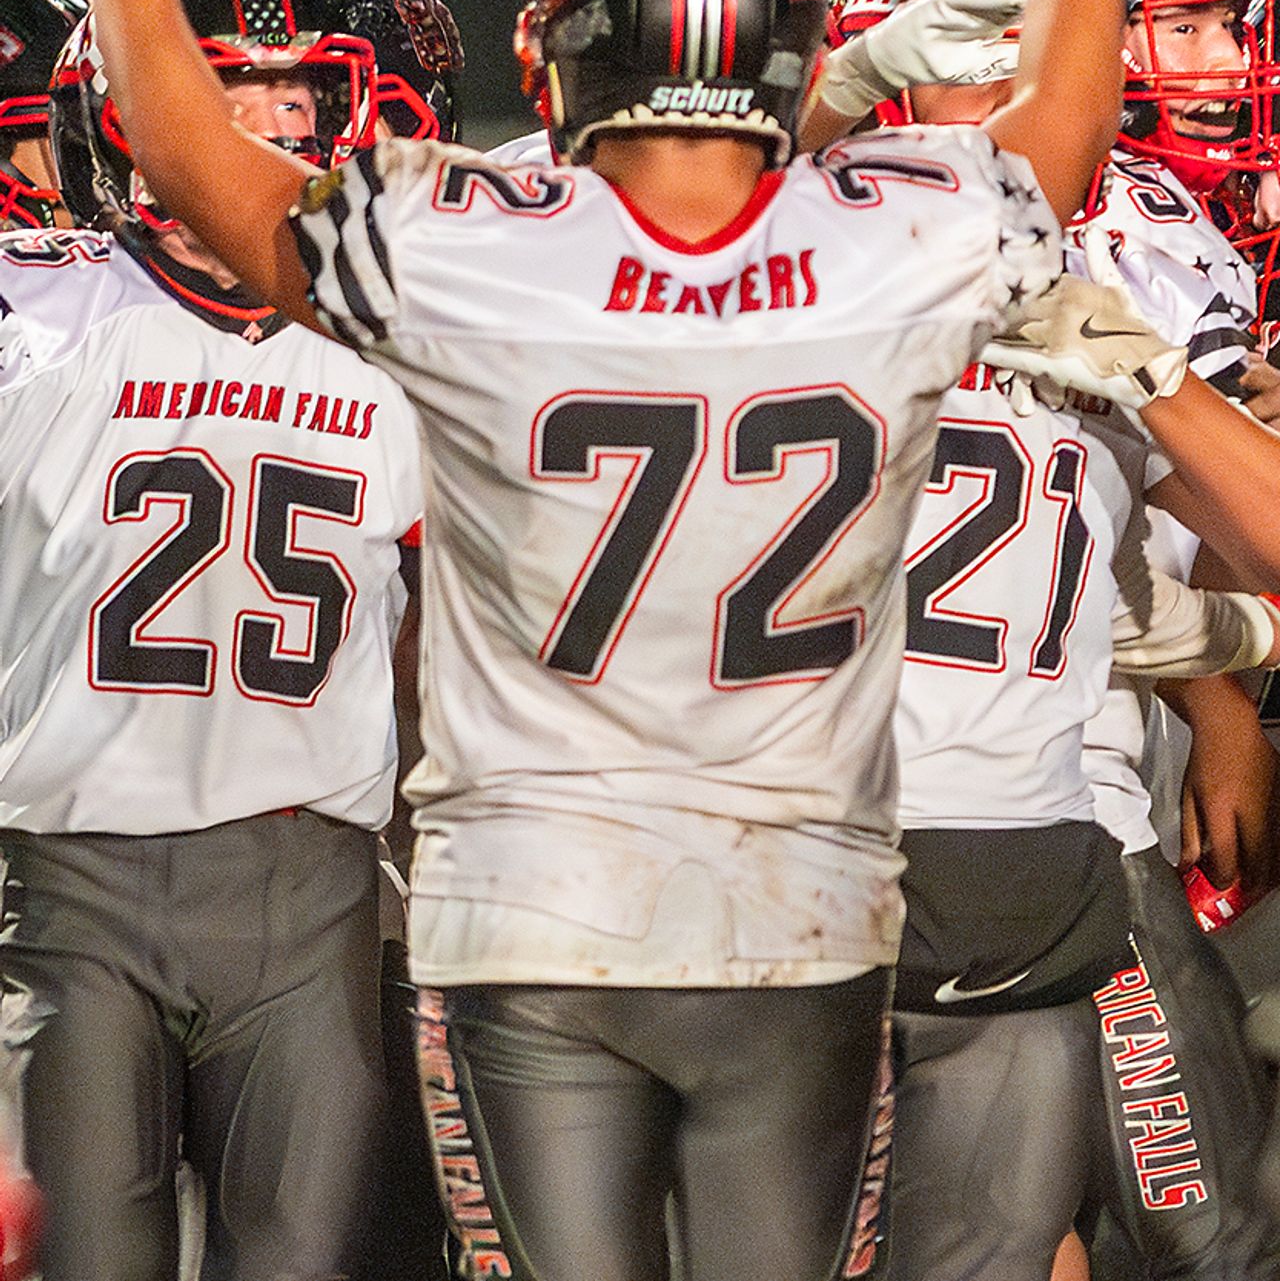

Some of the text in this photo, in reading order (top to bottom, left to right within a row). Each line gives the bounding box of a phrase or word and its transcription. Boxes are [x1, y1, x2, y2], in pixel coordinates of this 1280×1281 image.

[648, 80, 755, 113] schutt
[602, 249, 818, 318] BEAVERS
[112, 379, 379, 440] AMERICAN FALLS
[87, 446, 368, 709] 25
[531, 381, 887, 692] 72
[904, 416, 1096, 680] 21
[1123, 1090, 1209, 1212] FALLS
